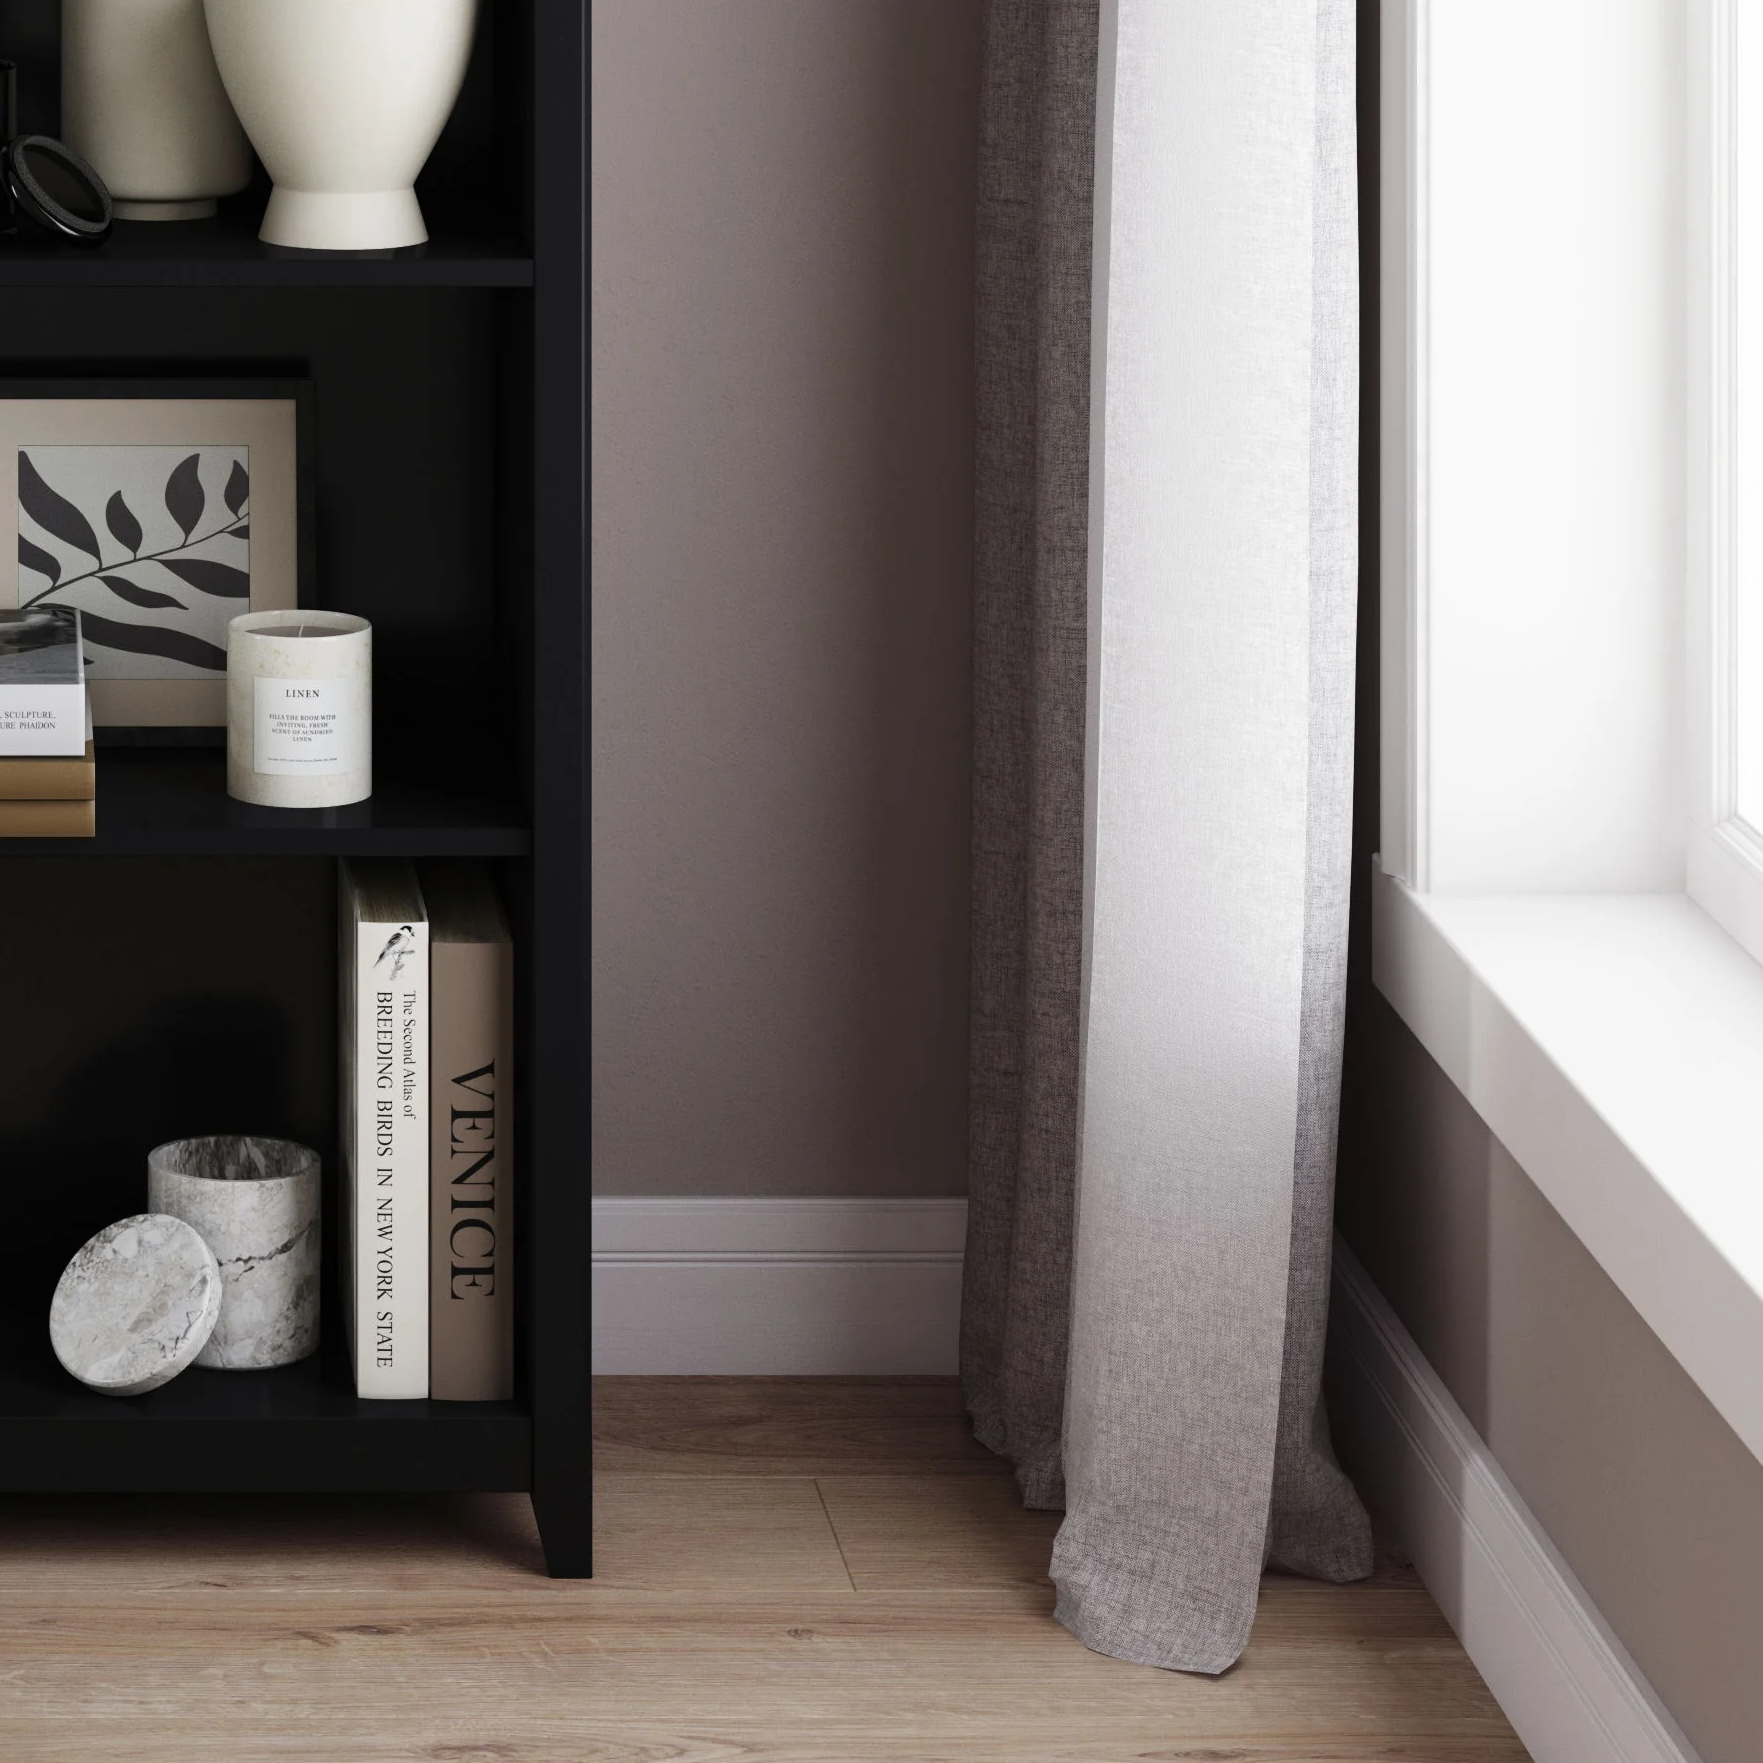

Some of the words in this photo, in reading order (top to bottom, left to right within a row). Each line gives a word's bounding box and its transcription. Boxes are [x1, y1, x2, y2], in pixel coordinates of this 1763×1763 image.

[285, 689, 320, 698] LINEN
[4, 710, 56, 720] SCULPTURE,
[19, 721, 56, 730] PHAIDON
[402, 990, 417, 1015] The
[376, 991, 393, 1089] BREEDING
[403, 1018, 417, 1065] Second
[403, 1068, 417, 1101] Atlas
[376, 1100, 393, 1157] BIRDS
[403, 1104, 417, 1120] of
[376, 1168, 393, 1187] IN
[450, 1058, 496, 1300] VENICE
[376, 1197, 393, 1241] NEW
[376, 1246, 394, 1301] YORK
[376, 1311, 394, 1368] STATE
